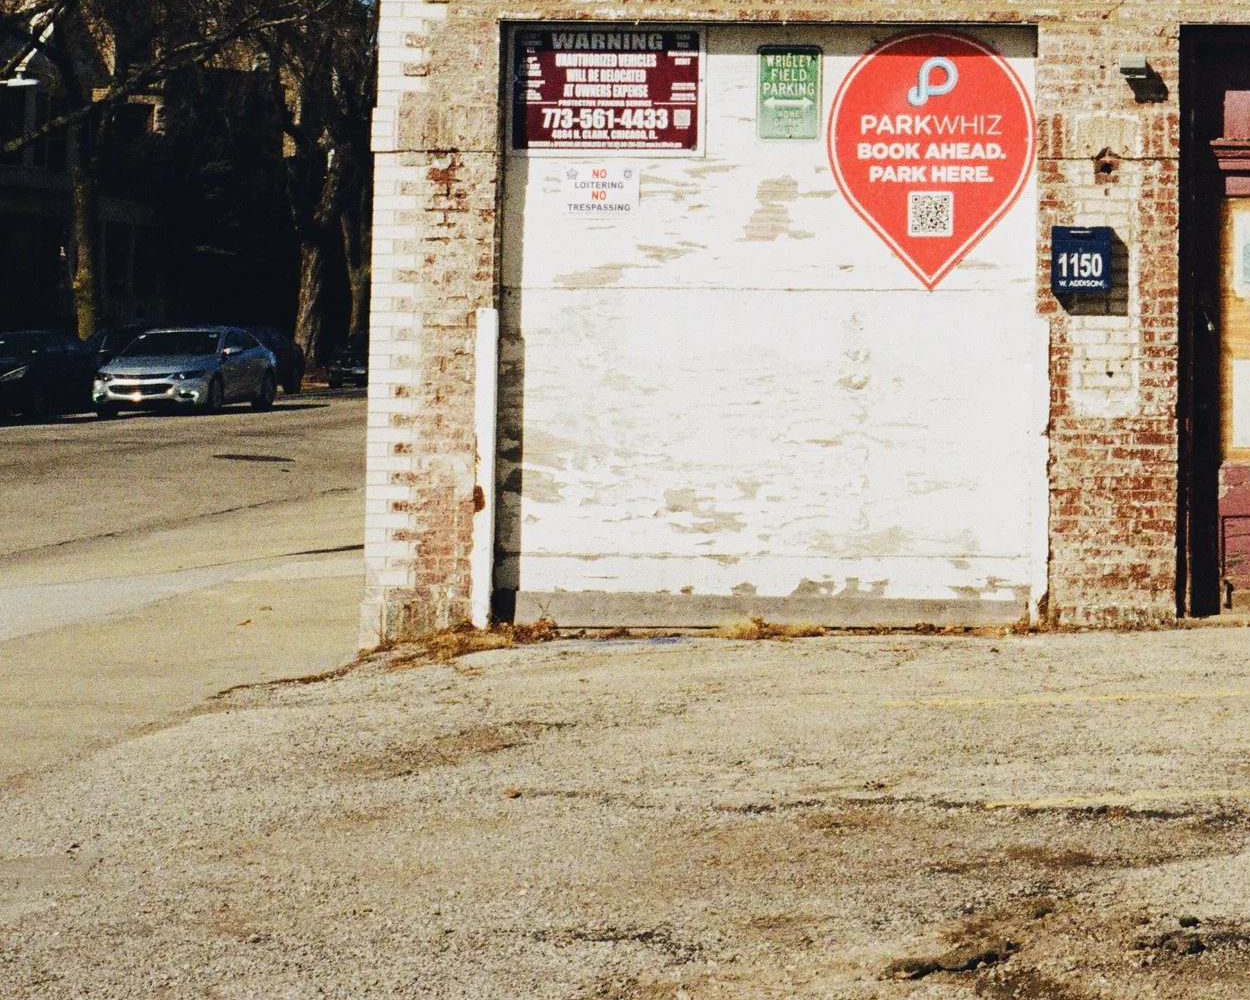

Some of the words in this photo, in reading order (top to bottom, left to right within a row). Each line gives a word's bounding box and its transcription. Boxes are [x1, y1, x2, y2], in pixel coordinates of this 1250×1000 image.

[552, 33, 663, 50] WARNING
[555, 53, 618, 67] UNAUTHORIZED
[618, 53, 657, 67] VEHICLES
[767, 55, 812, 67] WRIGLEY
[566, 69, 587, 82] WILL
[588, 69, 599, 82] BE
[600, 69, 647, 83] RELOCATED
[771, 69, 808, 82] FIELD
[563, 84, 574, 97] AT
[575, 84, 612, 98] OWNERS
[613, 84, 649, 98] EXPENSE
[763, 83, 815, 95] PARKING
[542, 108, 669, 129] 773-561-4433
[860, 114, 1003, 136] PARKWHIZ
[573, 129, 581, 139] N.
[857, 143, 921, 160] BOOK
[924, 143, 1007, 160] AHEAD.
[591, 168, 608, 179] NO
[869, 166, 926, 182] PARK
[931, 166, 994, 183] HERE.
[574, 181, 624, 189] LOITERING
[591, 190, 607, 200] NO
[568, 203, 631, 211] TRESPASSING
[1058, 252, 1103, 277] 1150
[1068, 280, 1104, 288] ADDISON
